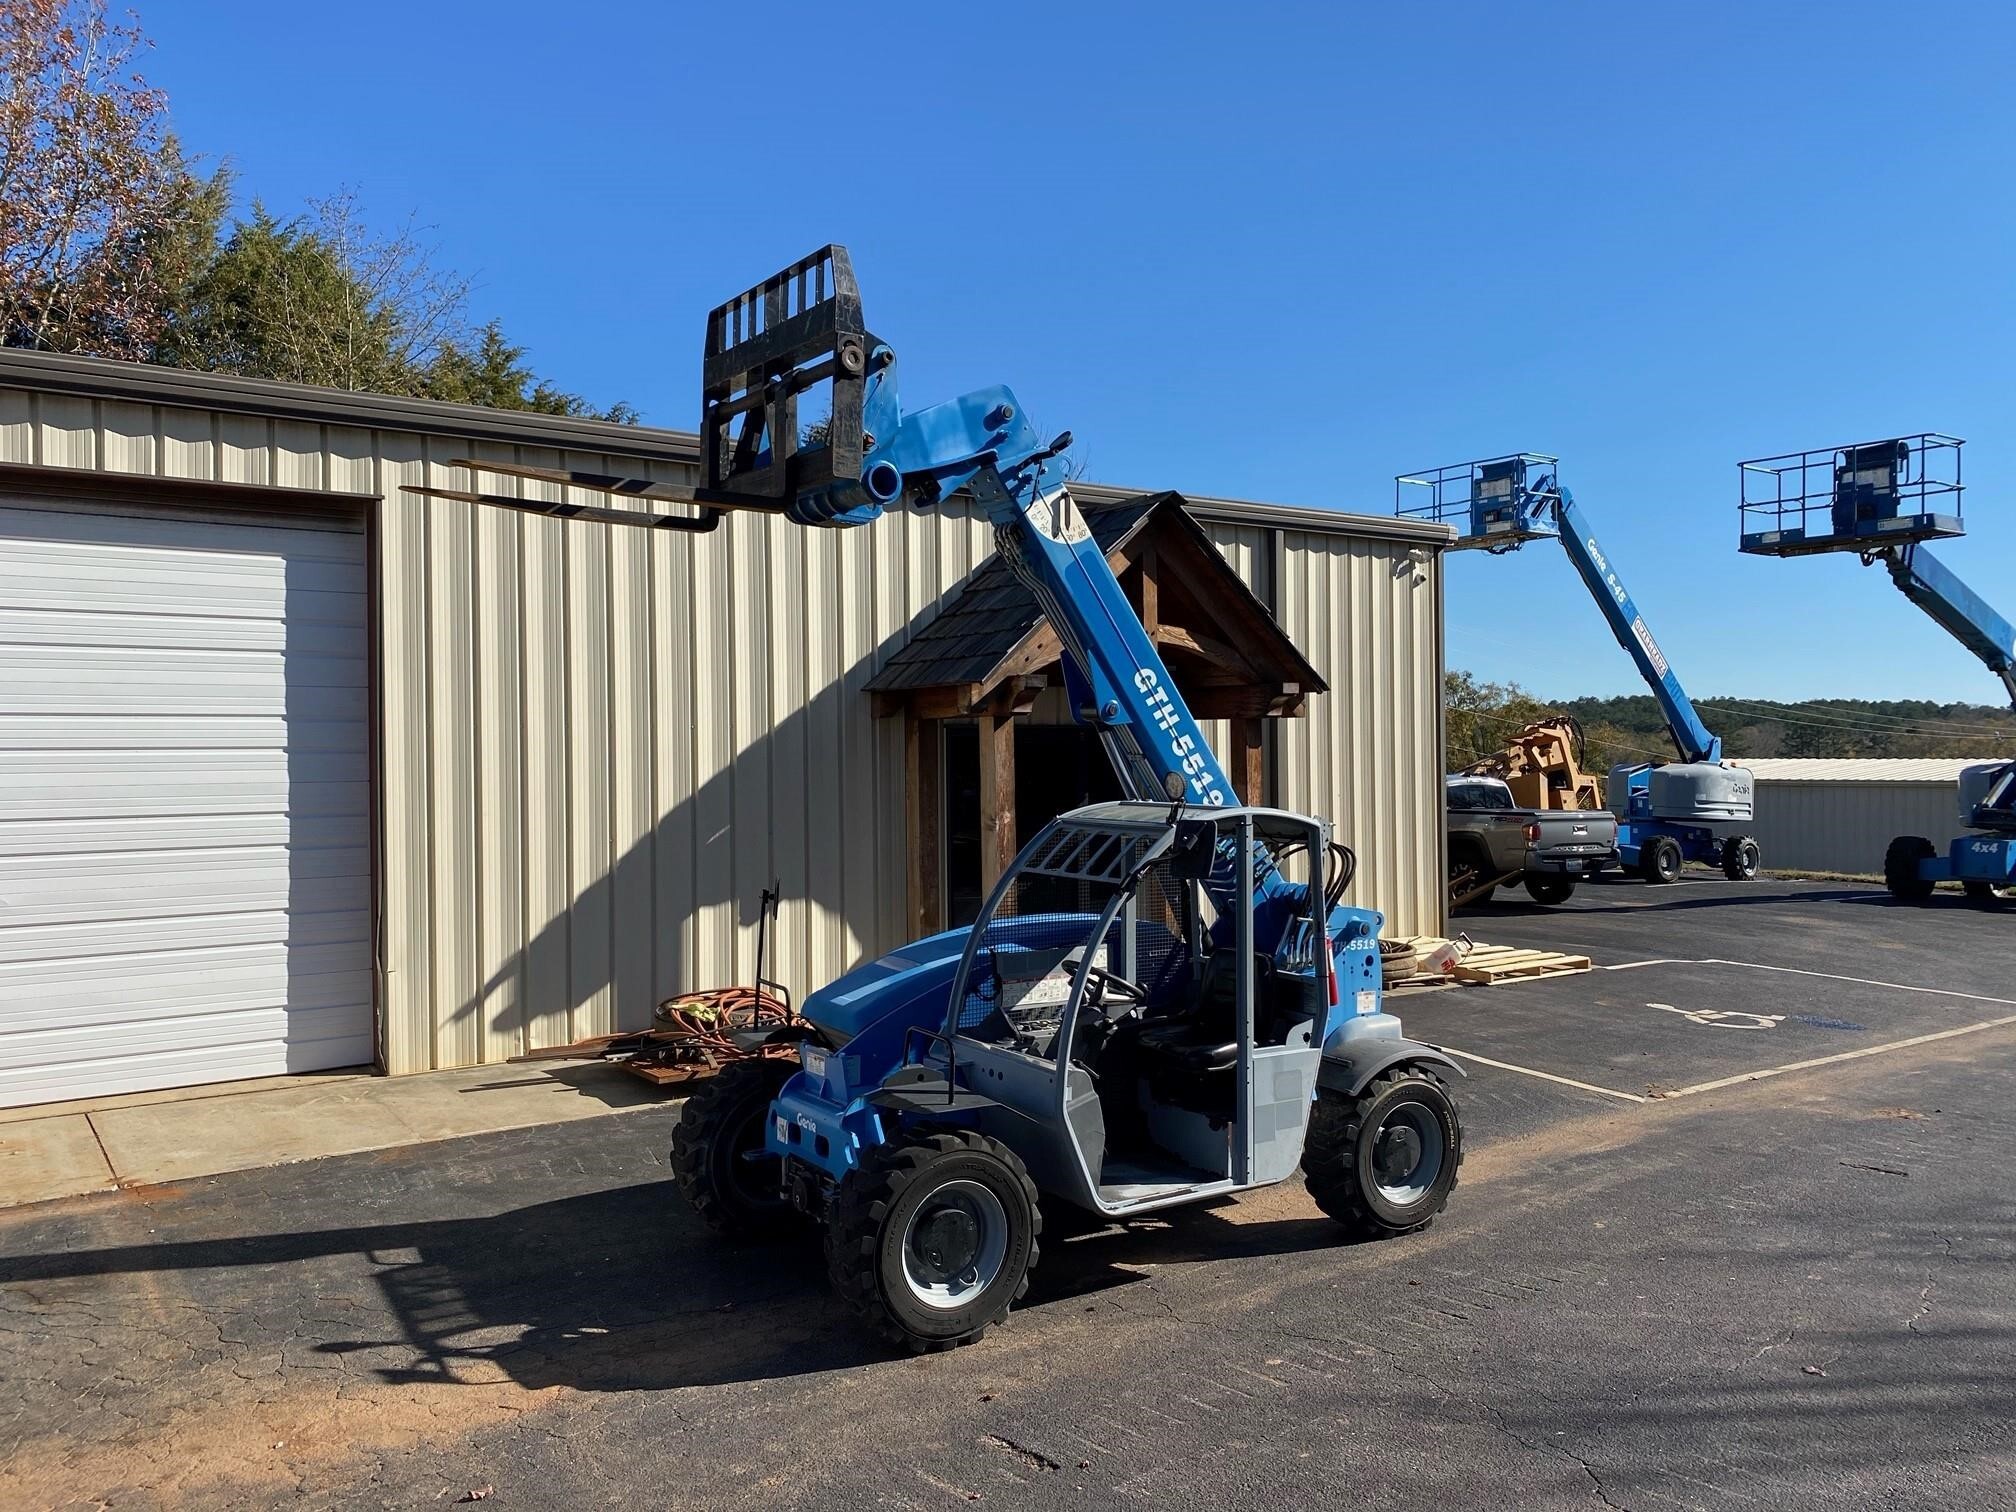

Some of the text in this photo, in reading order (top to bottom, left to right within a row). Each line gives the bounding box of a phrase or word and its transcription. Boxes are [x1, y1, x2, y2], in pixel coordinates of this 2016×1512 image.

[1588, 539, 1626, 603] Genie S-45
[1134, 668, 1224, 806] GTH-5519
[1971, 842, 1998, 853] 4x4
[797, 1112, 817, 1133] Genie
